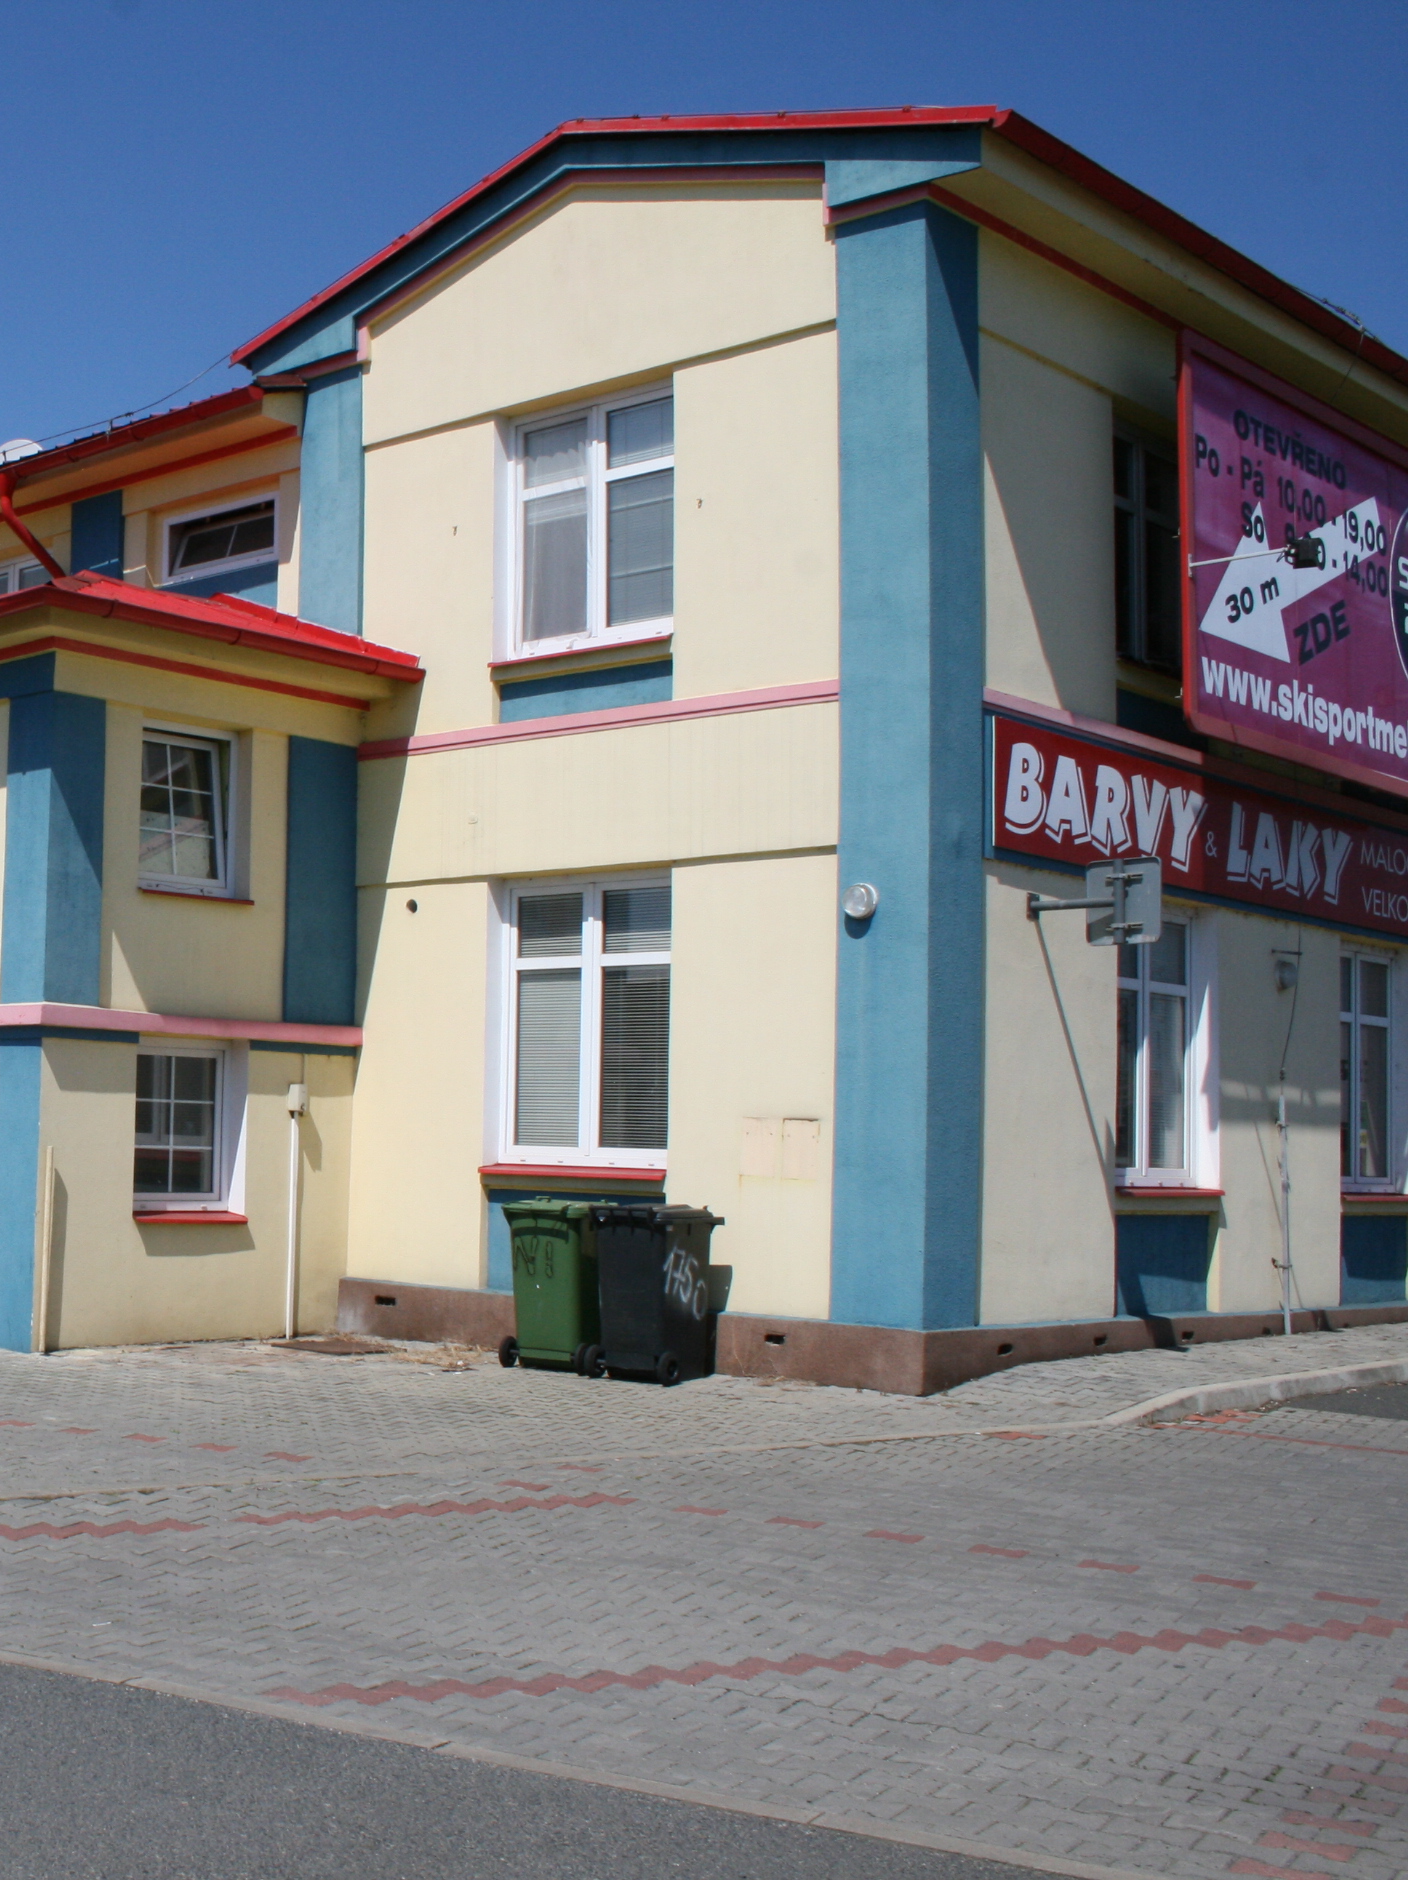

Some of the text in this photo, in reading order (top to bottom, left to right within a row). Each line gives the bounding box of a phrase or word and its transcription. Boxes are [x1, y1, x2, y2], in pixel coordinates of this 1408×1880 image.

[1233, 408, 1347, 490] OTEVŘENO
[1194, 433, 1220, 478] Po
[1241, 455, 1265, 500] Pá
[1277, 476, 1326, 527] 10,00
[1343, 509, 1387, 557] 19,00
[1242, 502, 1265, 543] So
[1343, 550, 1389, 598] 14,00
[1225, 577, 1280, 624] 30 m
[1293, 601, 1351, 666] ZDE
[1004, 742, 1353, 905] BARVY & LAKY
[1360, 841, 1408, 875] MALO
